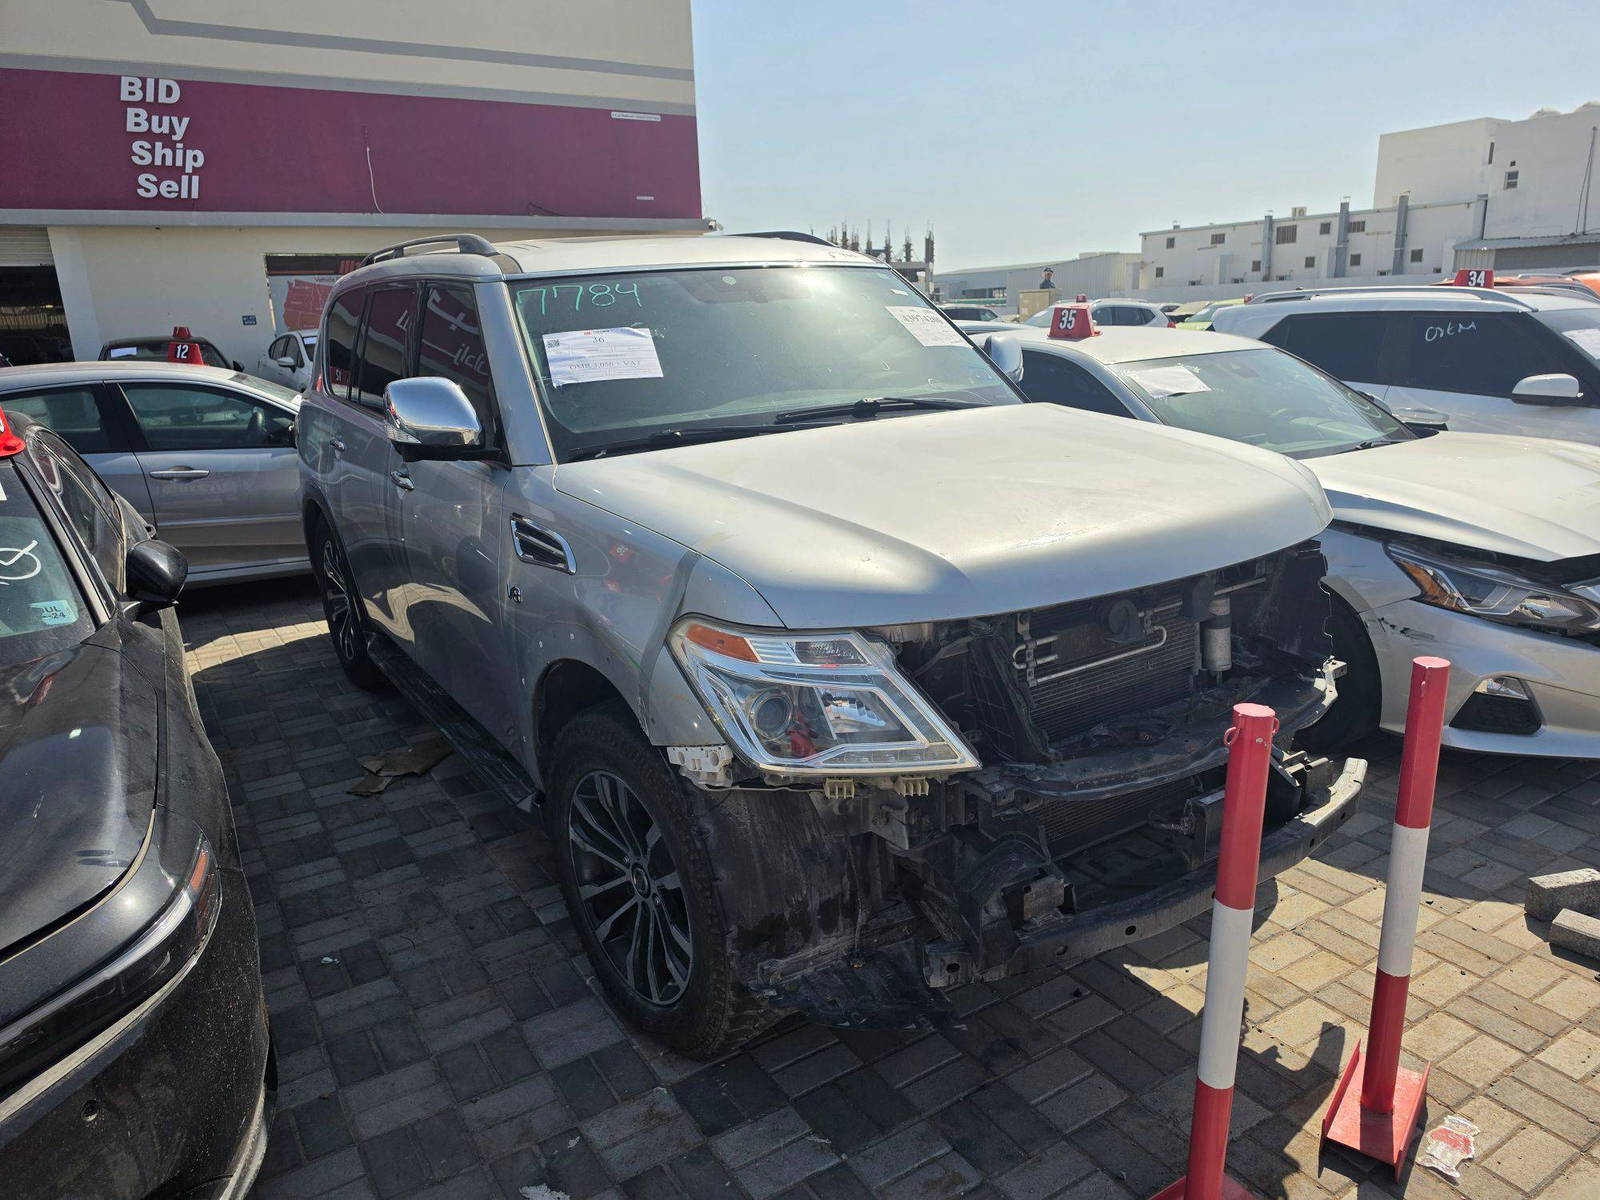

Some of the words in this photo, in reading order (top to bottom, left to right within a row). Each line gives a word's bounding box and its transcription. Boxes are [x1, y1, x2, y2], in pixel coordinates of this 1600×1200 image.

[120, 76, 180, 104] BID
[126, 107, 190, 141] Buy
[131, 140, 205, 173] Ship
[137, 173, 200, 199] Sell
[1468, 270, 1486, 287] 34
[515, 281, 642, 315] 7784
[1059, 309, 1077, 330] 35
[176, 344, 189, 359] 12
